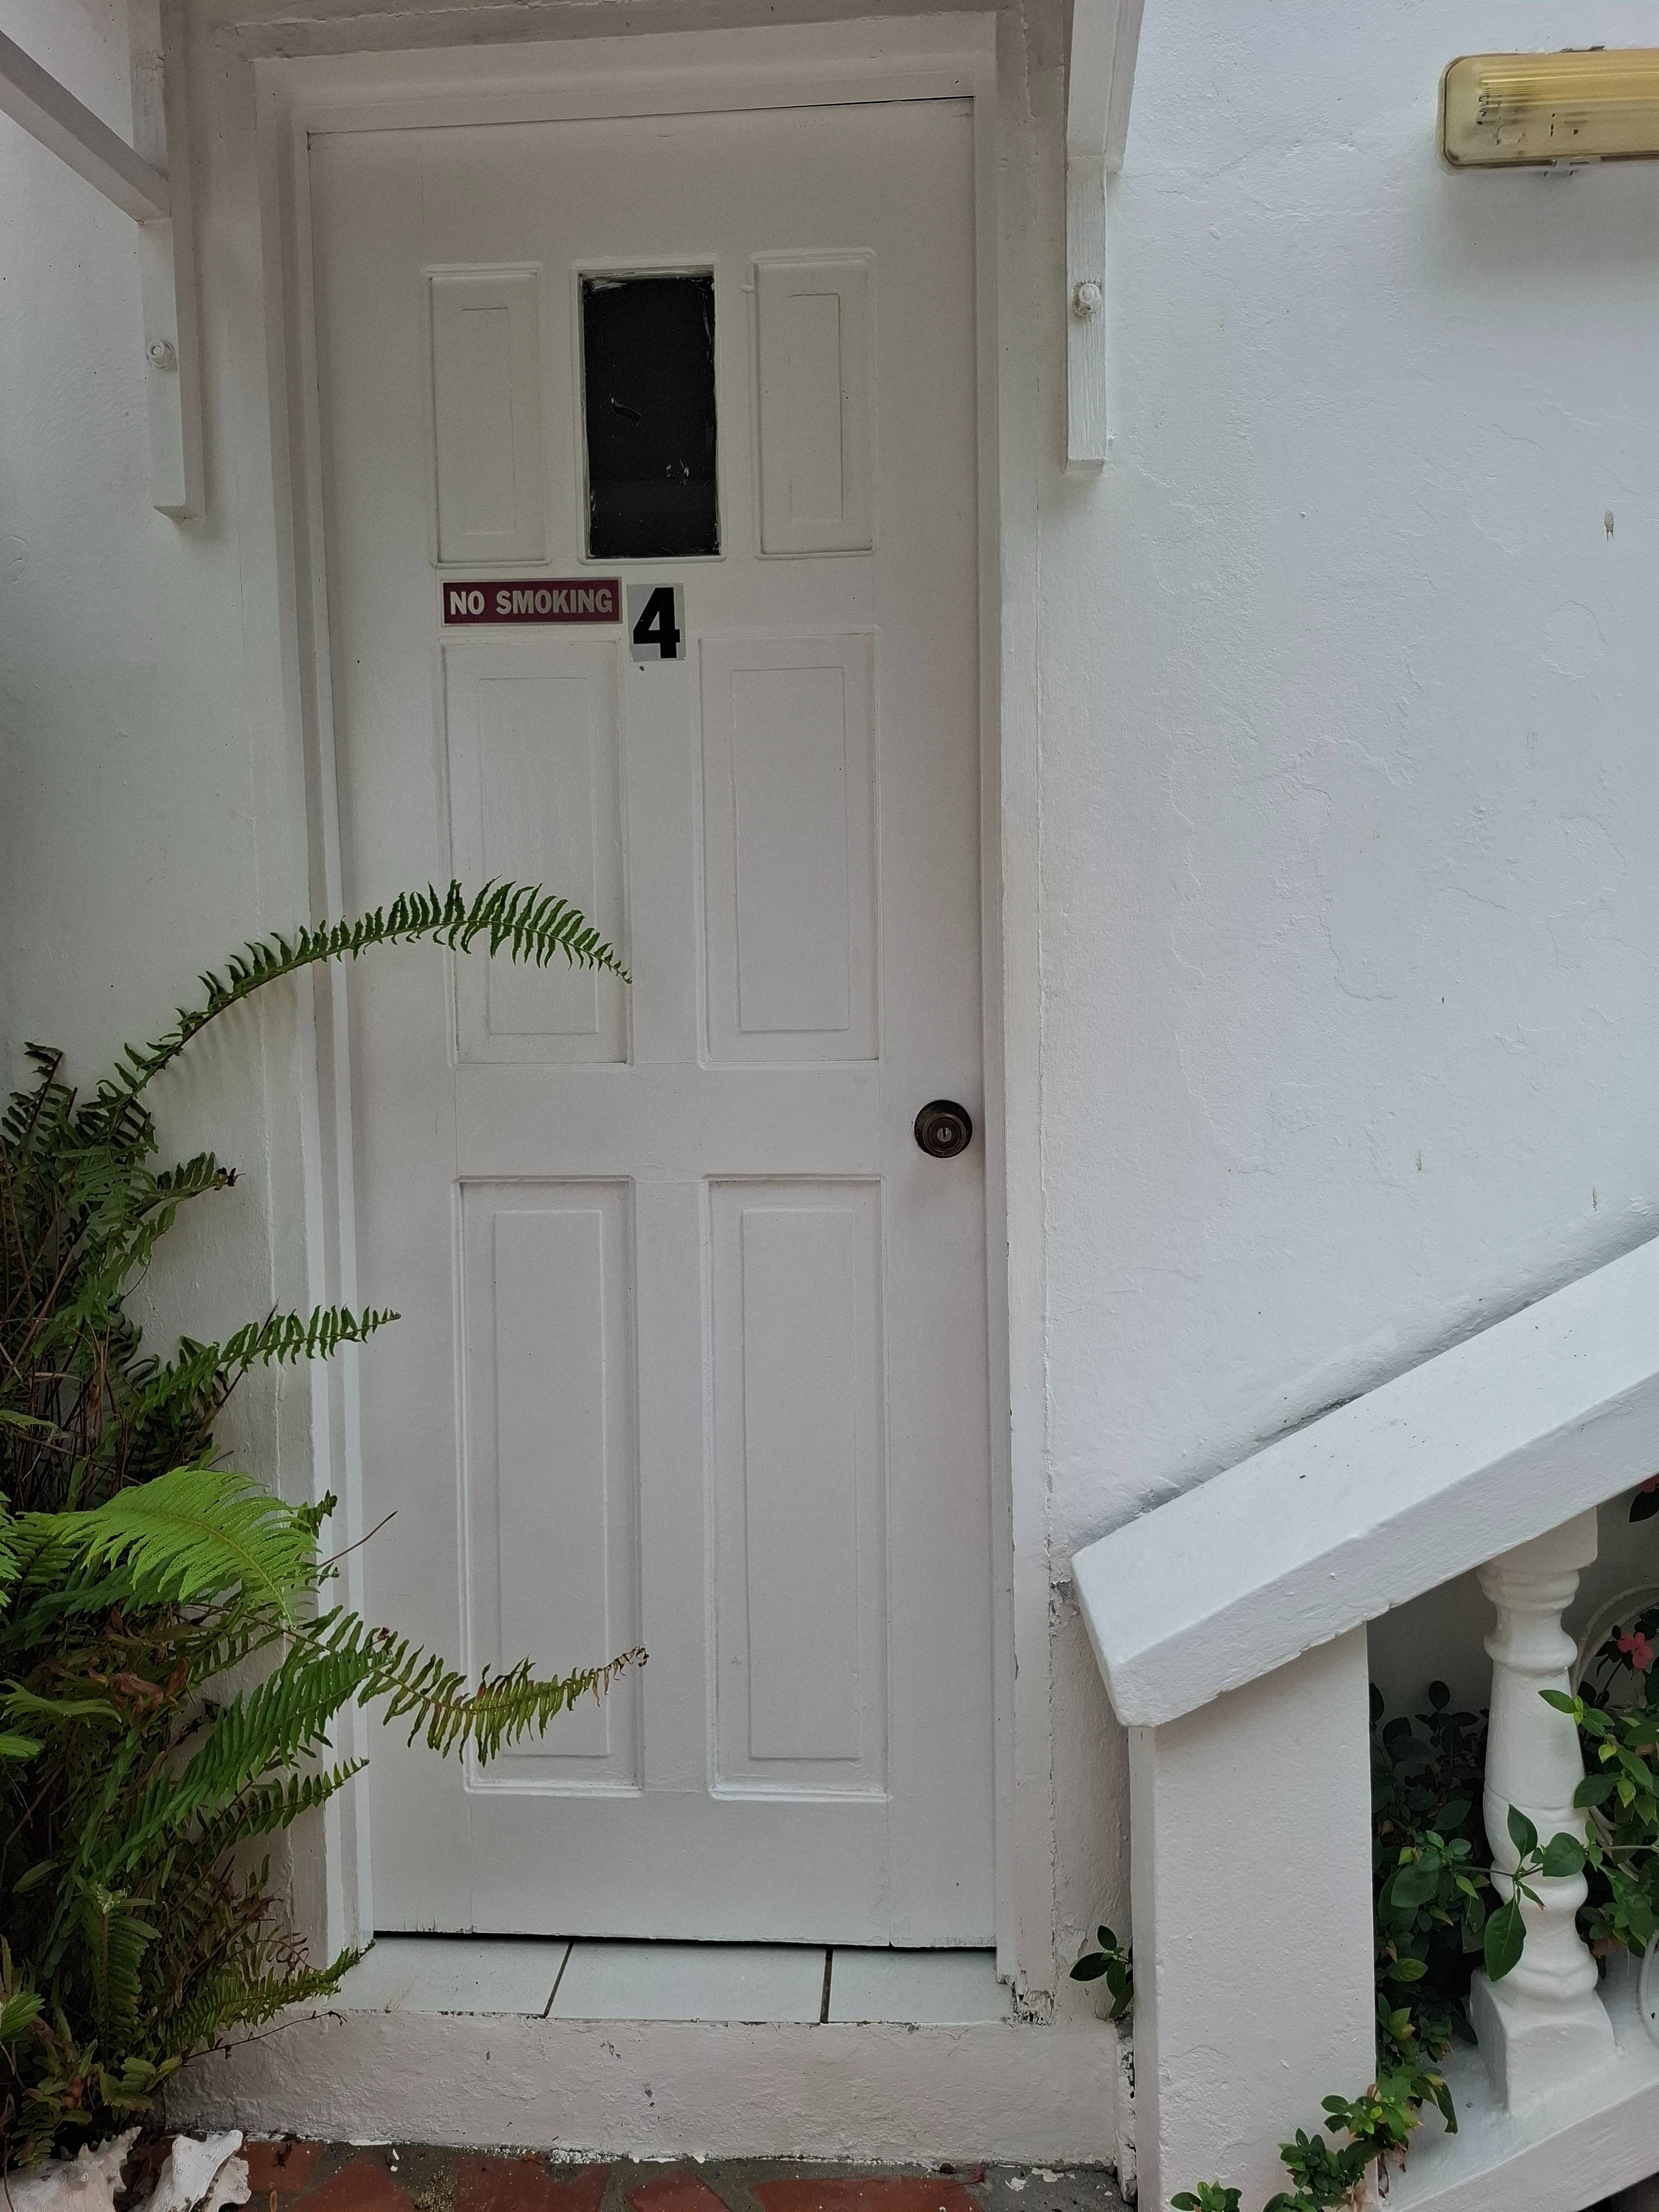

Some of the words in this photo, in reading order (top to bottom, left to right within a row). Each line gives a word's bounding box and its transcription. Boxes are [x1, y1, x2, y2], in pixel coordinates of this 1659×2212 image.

[450, 590, 485, 615] NO
[496, 589, 613, 615] SMOKING
[633, 587, 680, 659] 4
